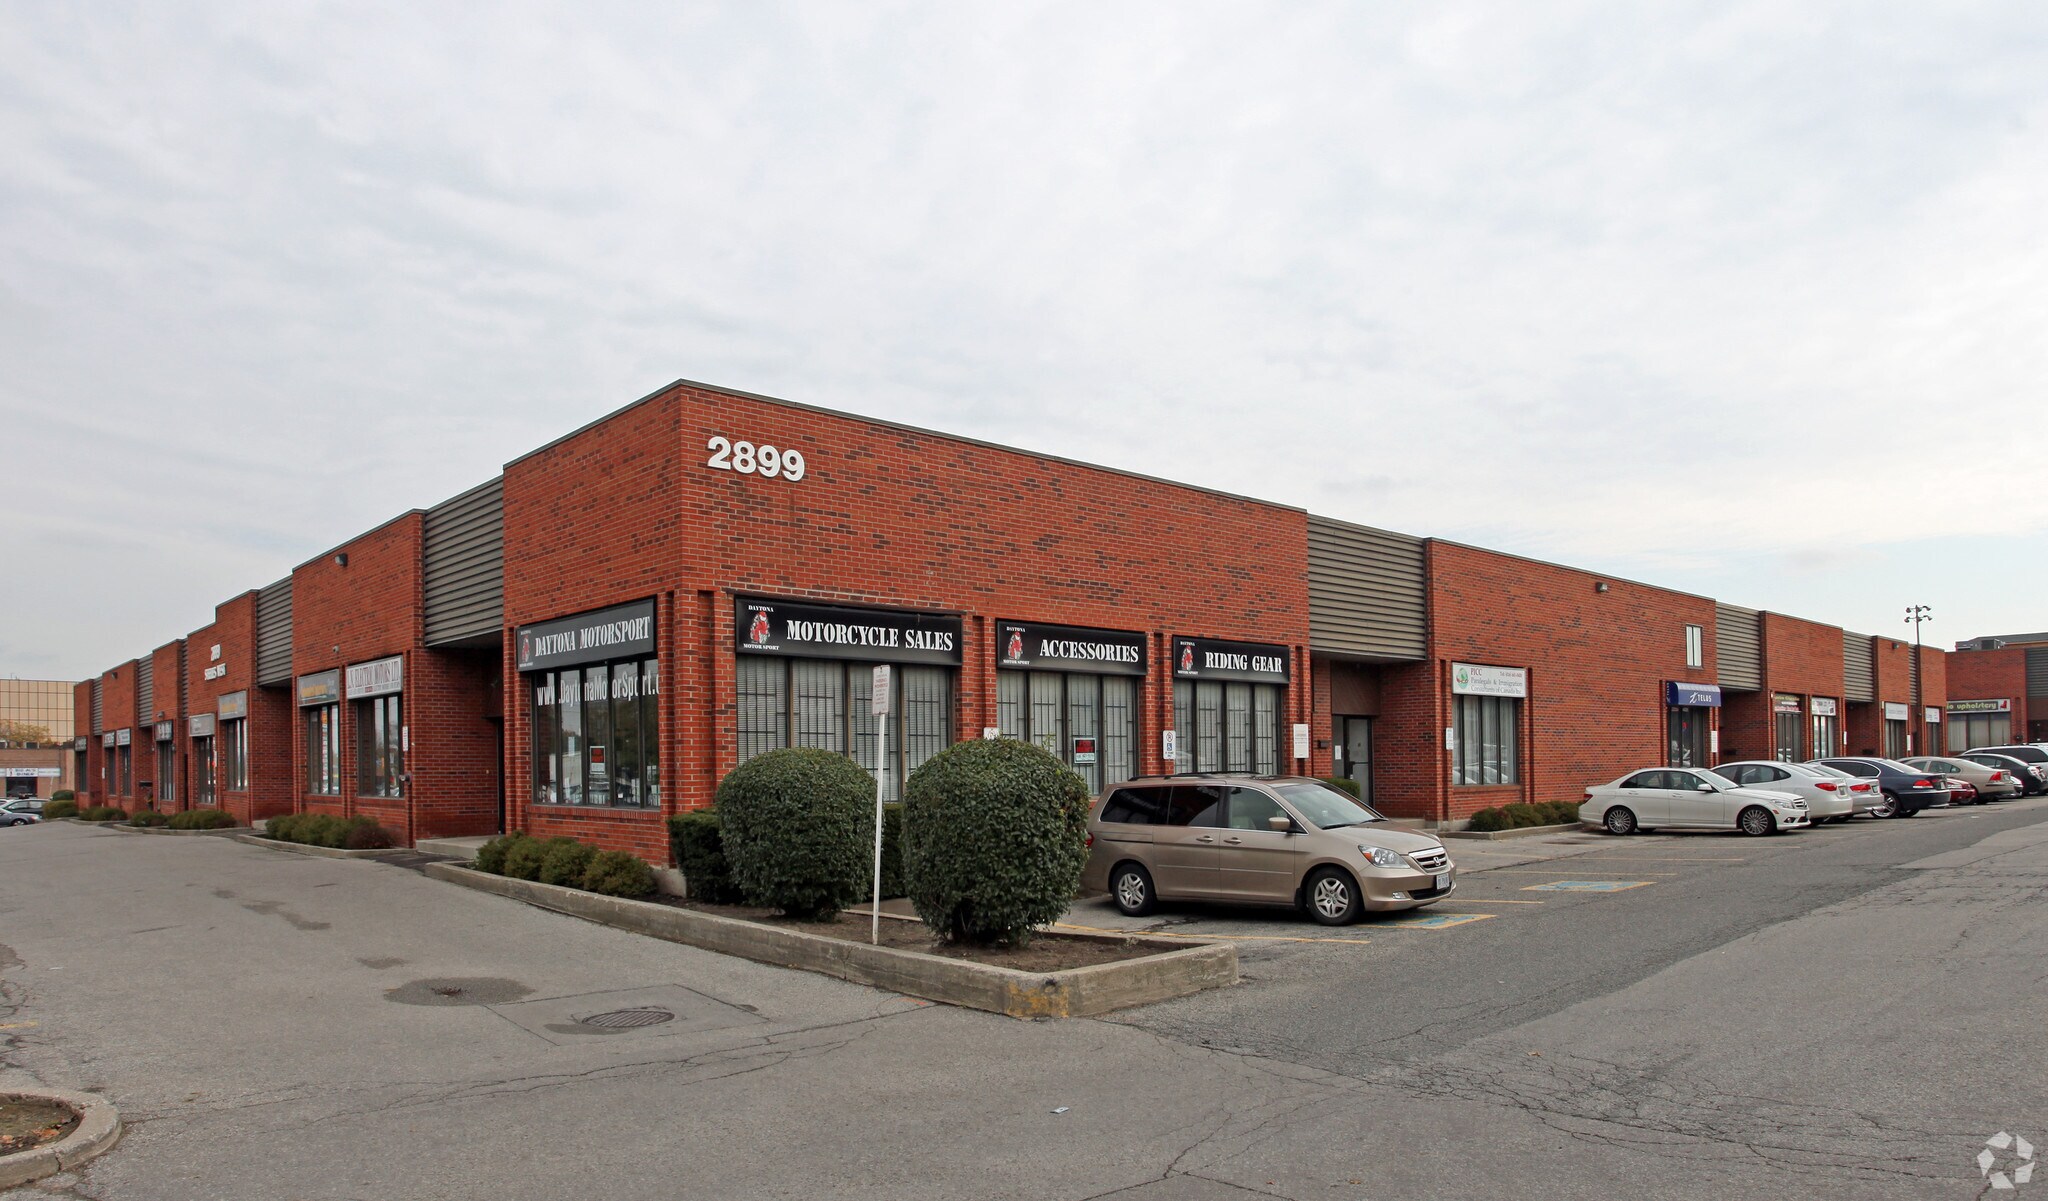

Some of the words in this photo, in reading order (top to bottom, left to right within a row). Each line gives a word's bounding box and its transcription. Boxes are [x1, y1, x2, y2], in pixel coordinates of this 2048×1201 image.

[707, 436, 805, 481] 2899
[535, 631, 576, 657] DAYTONA
[580, 616, 650, 649] MOTORSPORT
[787, 620, 899, 648] MOTORCYCLE
[905, 629, 953, 651] SALES
[1040, 639, 1139, 663] ACCESSORIES
[1205, 651, 1248, 670] RIDING
[1251, 655, 1282, 673] GEAR
[1697, 694, 1712, 702] TELUS
[1957, 702, 1997, 710] upholstery
